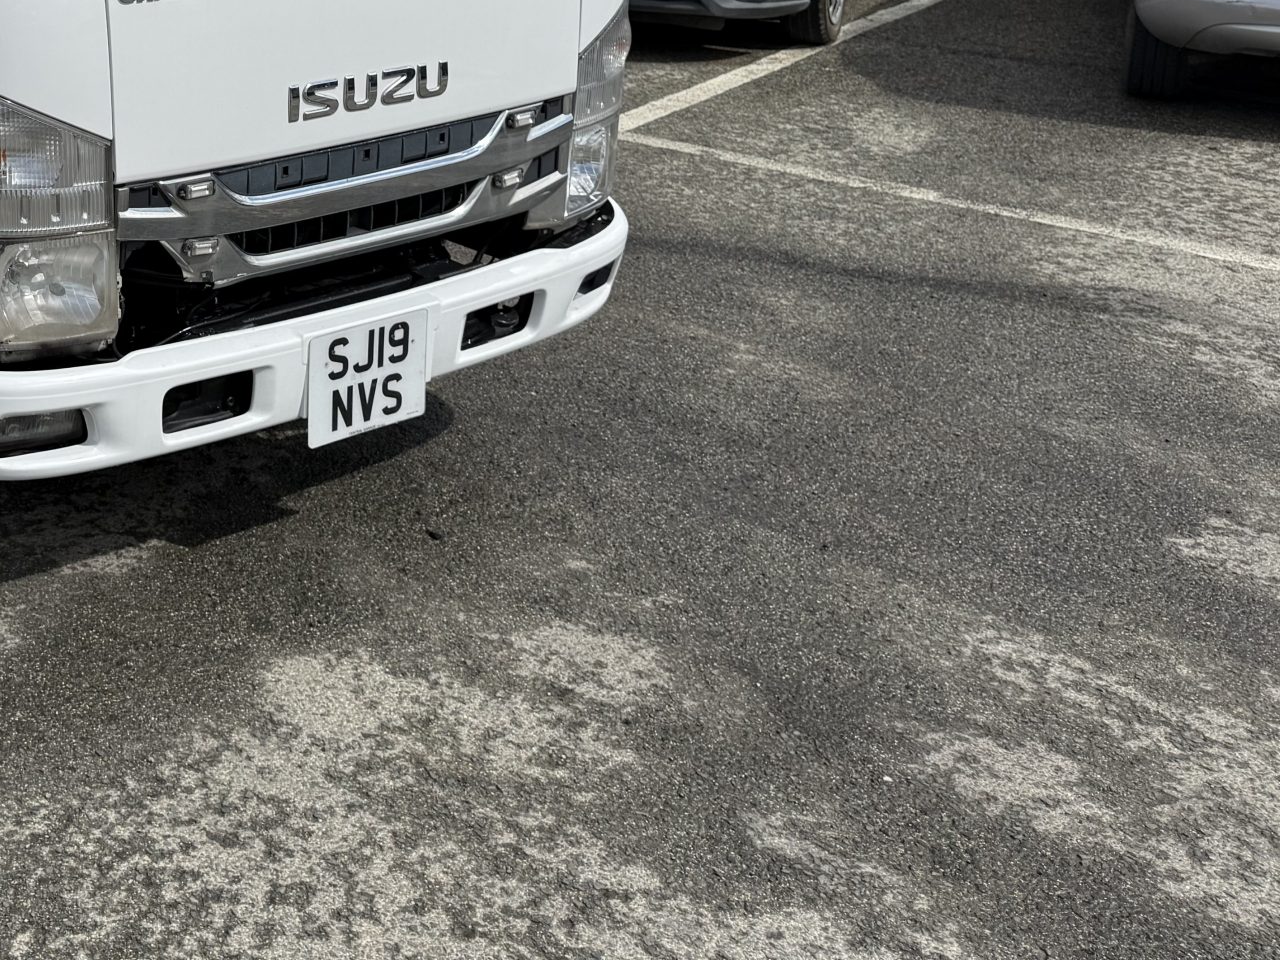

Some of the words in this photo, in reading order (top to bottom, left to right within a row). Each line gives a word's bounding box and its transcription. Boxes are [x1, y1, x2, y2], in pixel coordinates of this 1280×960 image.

[288, 59, 449, 123] ISUZU
[328, 321, 410, 381] SJ19
[331, 373, 402, 432] NVS
